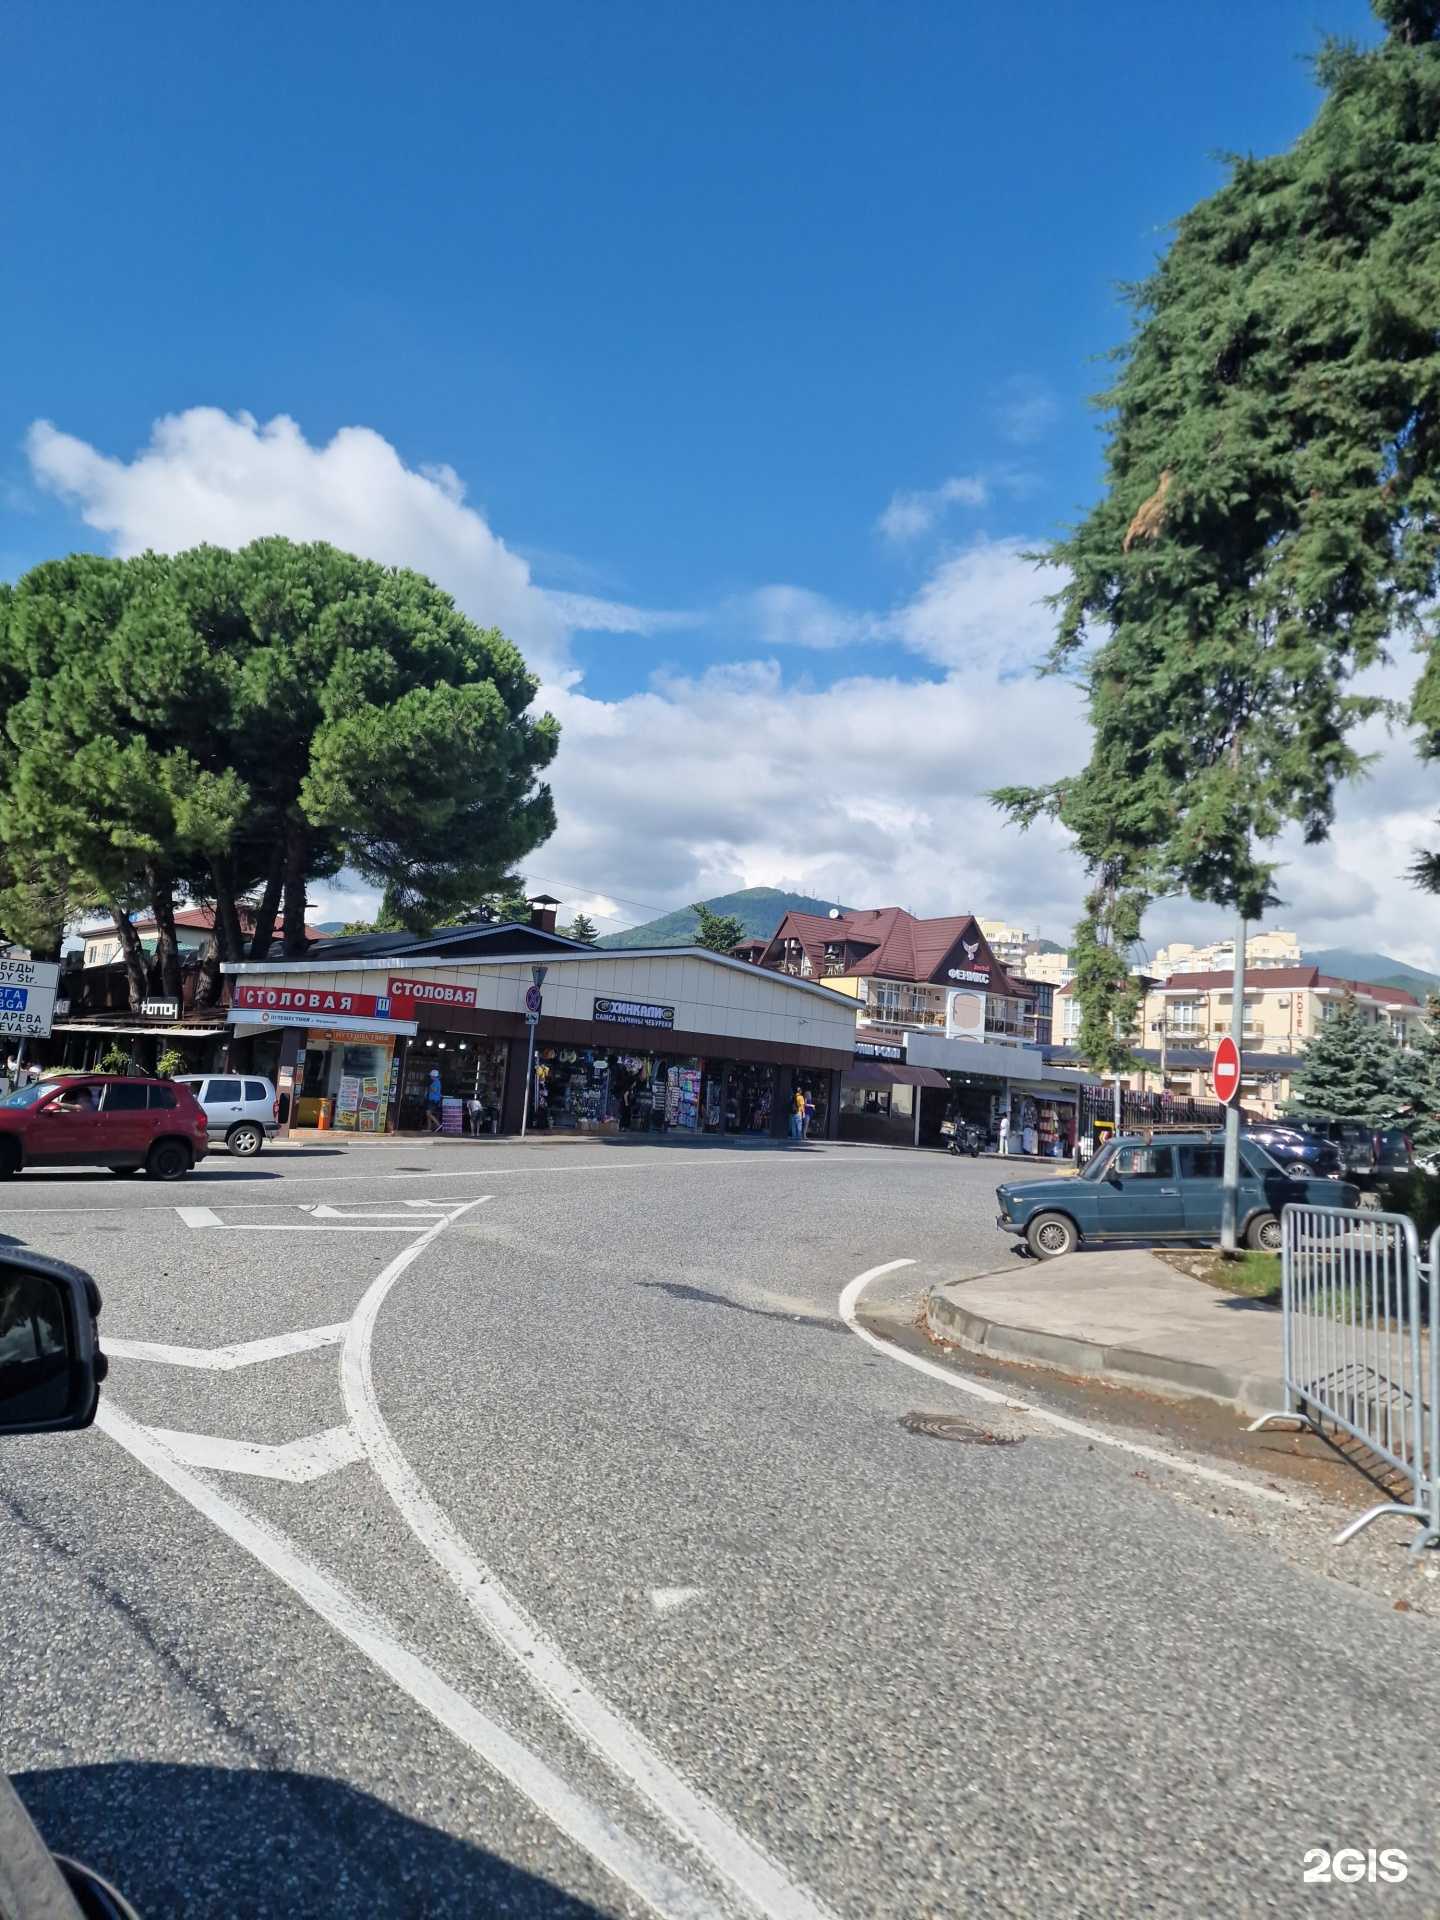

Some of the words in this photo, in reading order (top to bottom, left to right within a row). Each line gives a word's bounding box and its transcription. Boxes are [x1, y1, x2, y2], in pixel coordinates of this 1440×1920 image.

[17, 973, 38, 983] Str.
[246, 990, 352, 1010] СТОЛОВАЯ
[392, 982, 475, 1003] СТОЛОВАЯ
[0, 1012, 42, 1024] АРЕВА
[610, 1002, 663, 1019] ХИНКАЛИ
